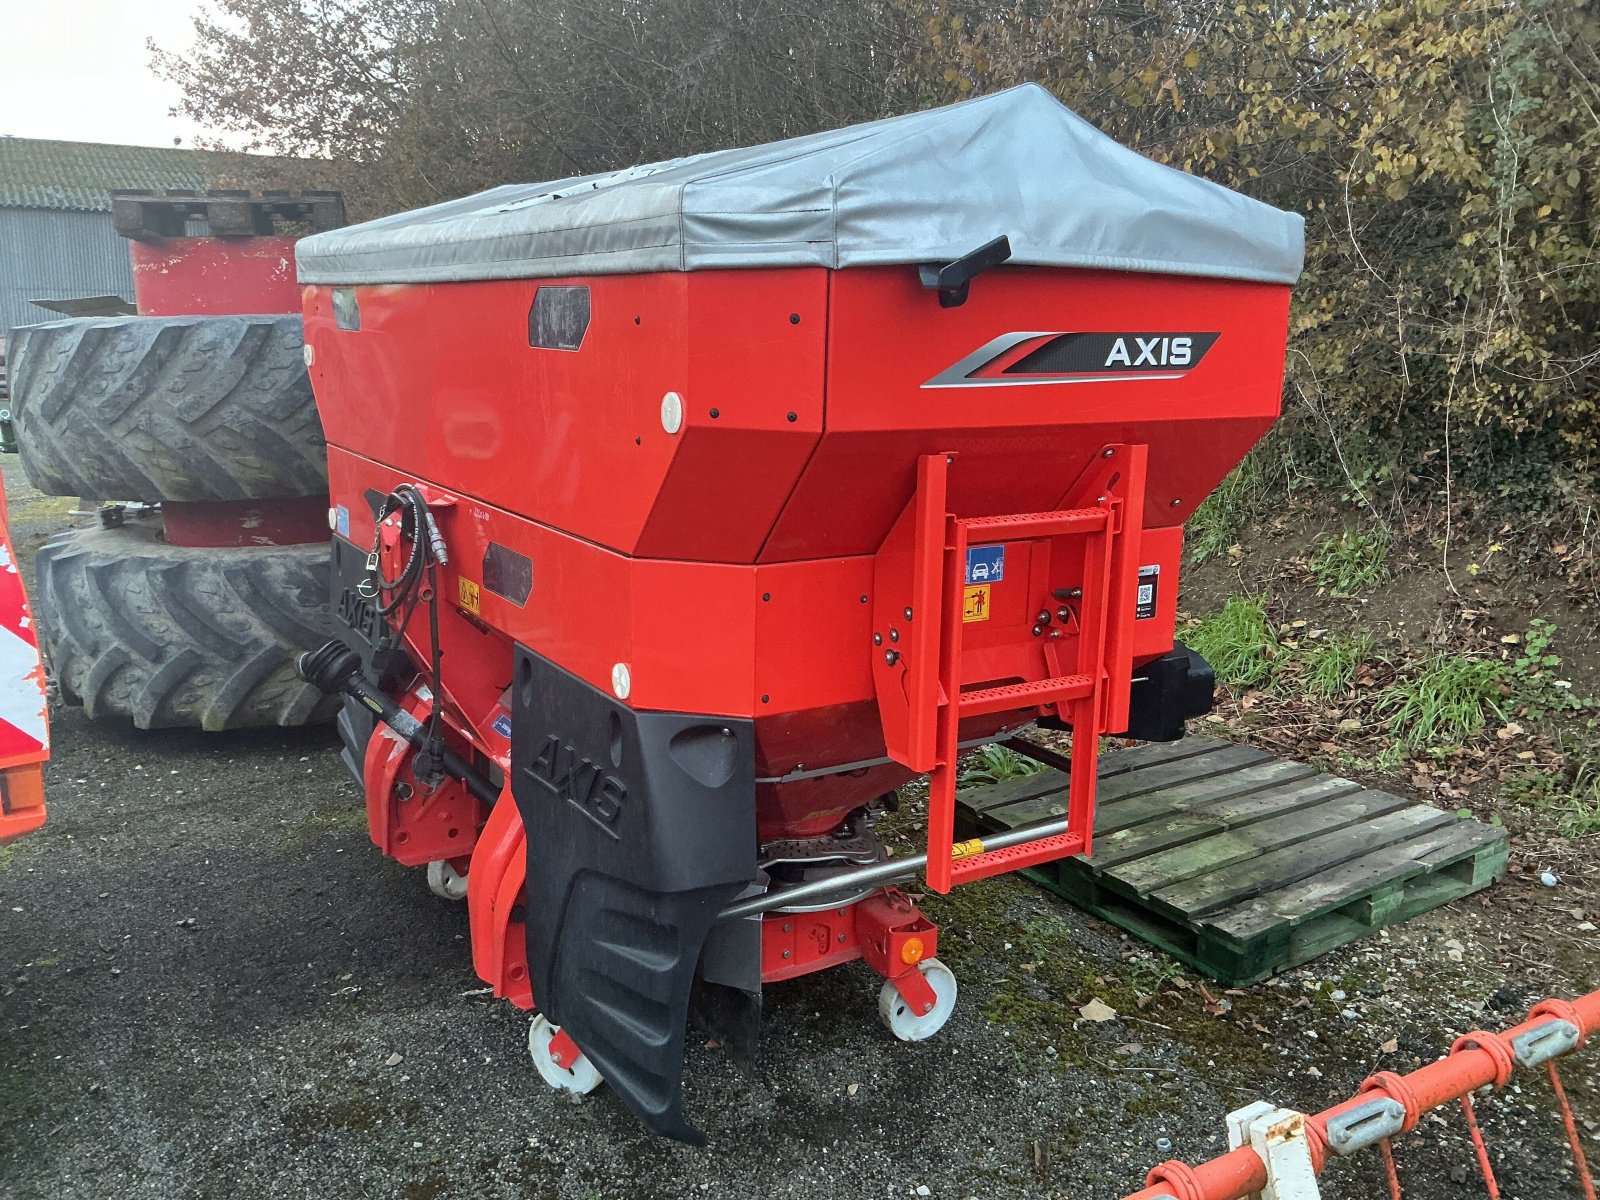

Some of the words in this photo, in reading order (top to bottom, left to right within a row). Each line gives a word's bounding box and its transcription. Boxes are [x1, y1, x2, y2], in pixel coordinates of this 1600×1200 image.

[1104, 337, 1192, 367] AXIS
[336, 586, 376, 637] AXIS
[525, 734, 627, 826] AXIS
